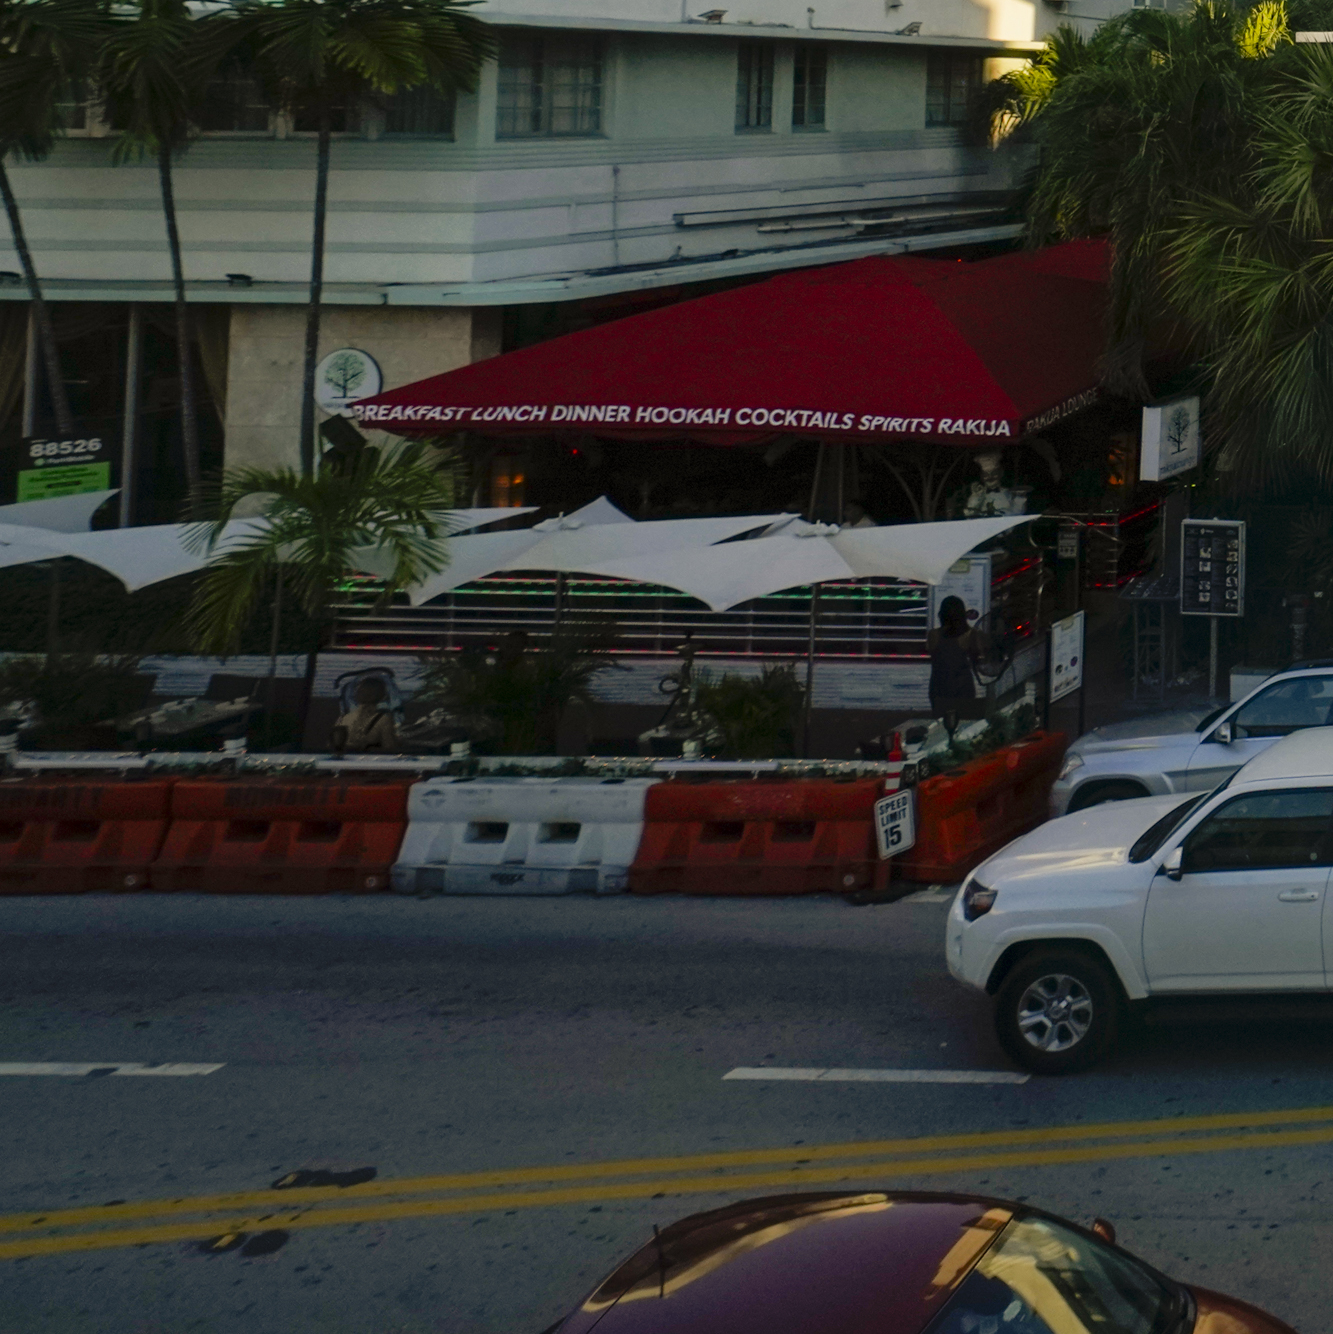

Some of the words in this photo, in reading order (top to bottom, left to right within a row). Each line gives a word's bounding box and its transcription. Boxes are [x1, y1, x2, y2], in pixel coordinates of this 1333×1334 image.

[1062, 387, 1098, 417] LOUNGE
[354, 404, 473, 422] BREAKFAST
[470, 404, 548, 421] LUNCH
[550, 405, 631, 422] DINNER
[635, 406, 731, 424] HOOKAH
[734, 408, 854, 429] COCKTAILS
[856, 416, 936, 433] SPIRITS
[937, 418, 1012, 436] RAKIJA
[29, 438, 103, 458] 88526
[879, 796, 908, 816] SPEED
[880, 807, 908, 827] LIMIT
[884, 824, 903, 850] 15
